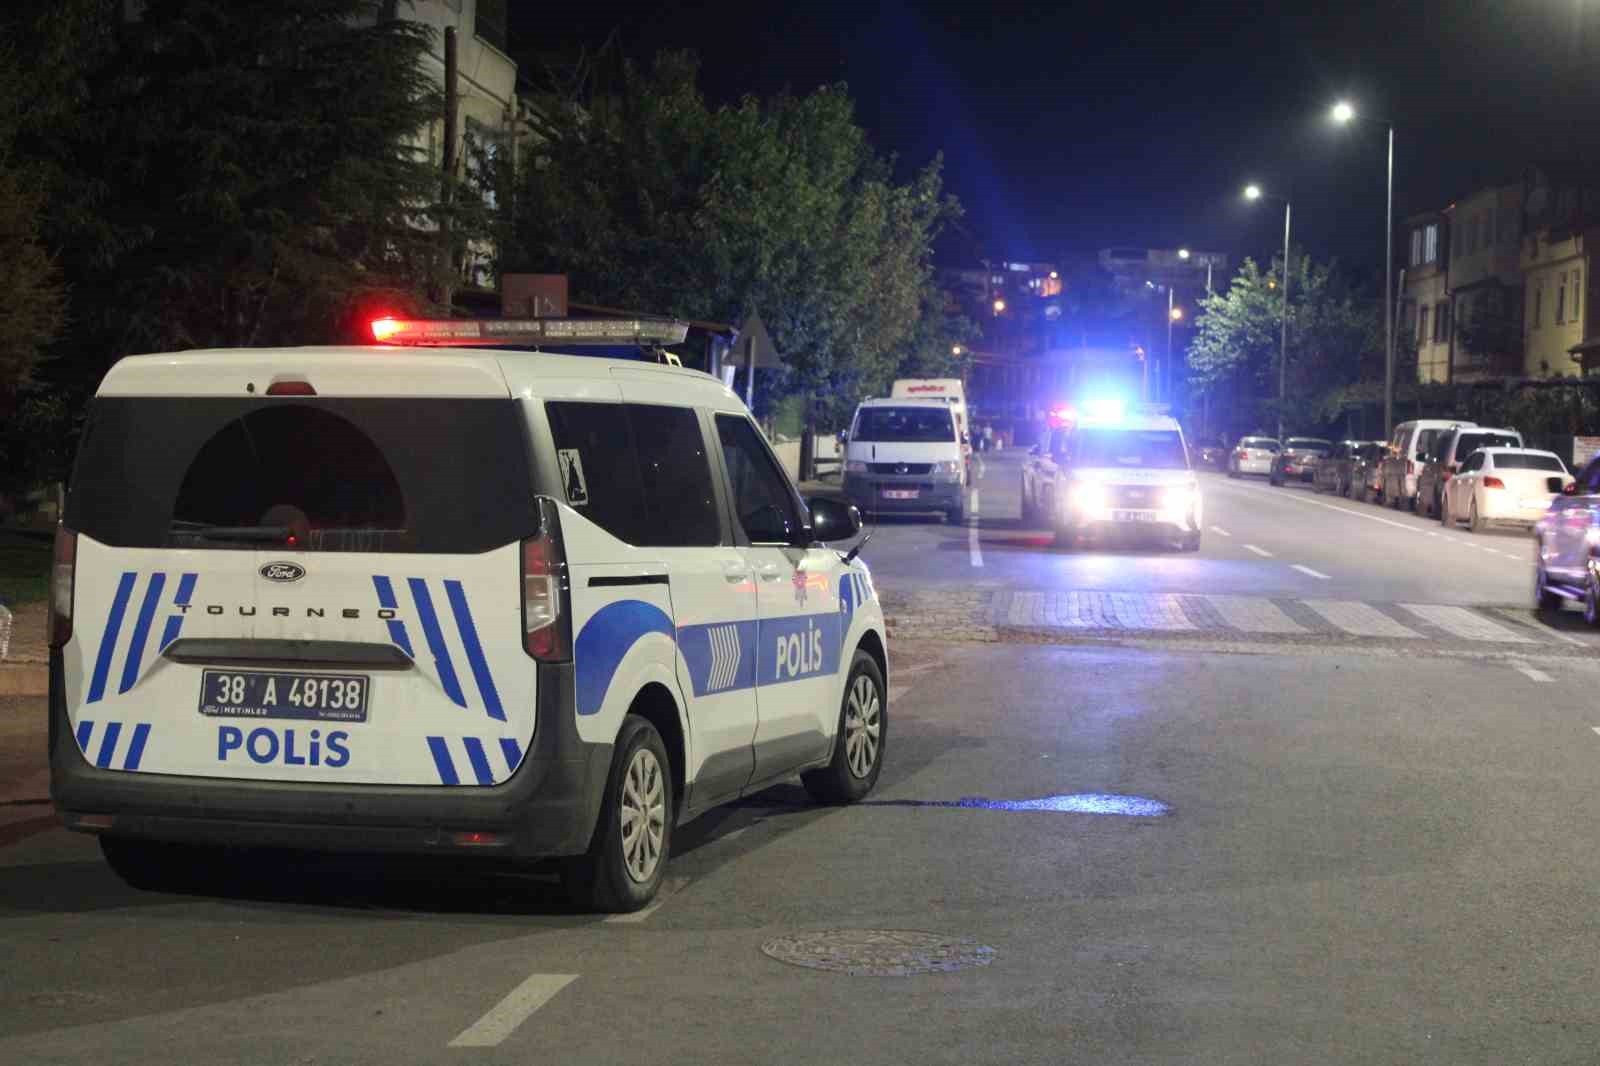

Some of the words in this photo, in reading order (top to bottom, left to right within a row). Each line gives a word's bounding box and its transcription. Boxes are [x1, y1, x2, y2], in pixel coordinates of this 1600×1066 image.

[267, 565, 296, 578] Ford
[176, 604, 396, 619] TOURNEO
[216, 675, 246, 704] 38
[262, 677, 277, 706] A
[288, 678, 361, 709] 48138
